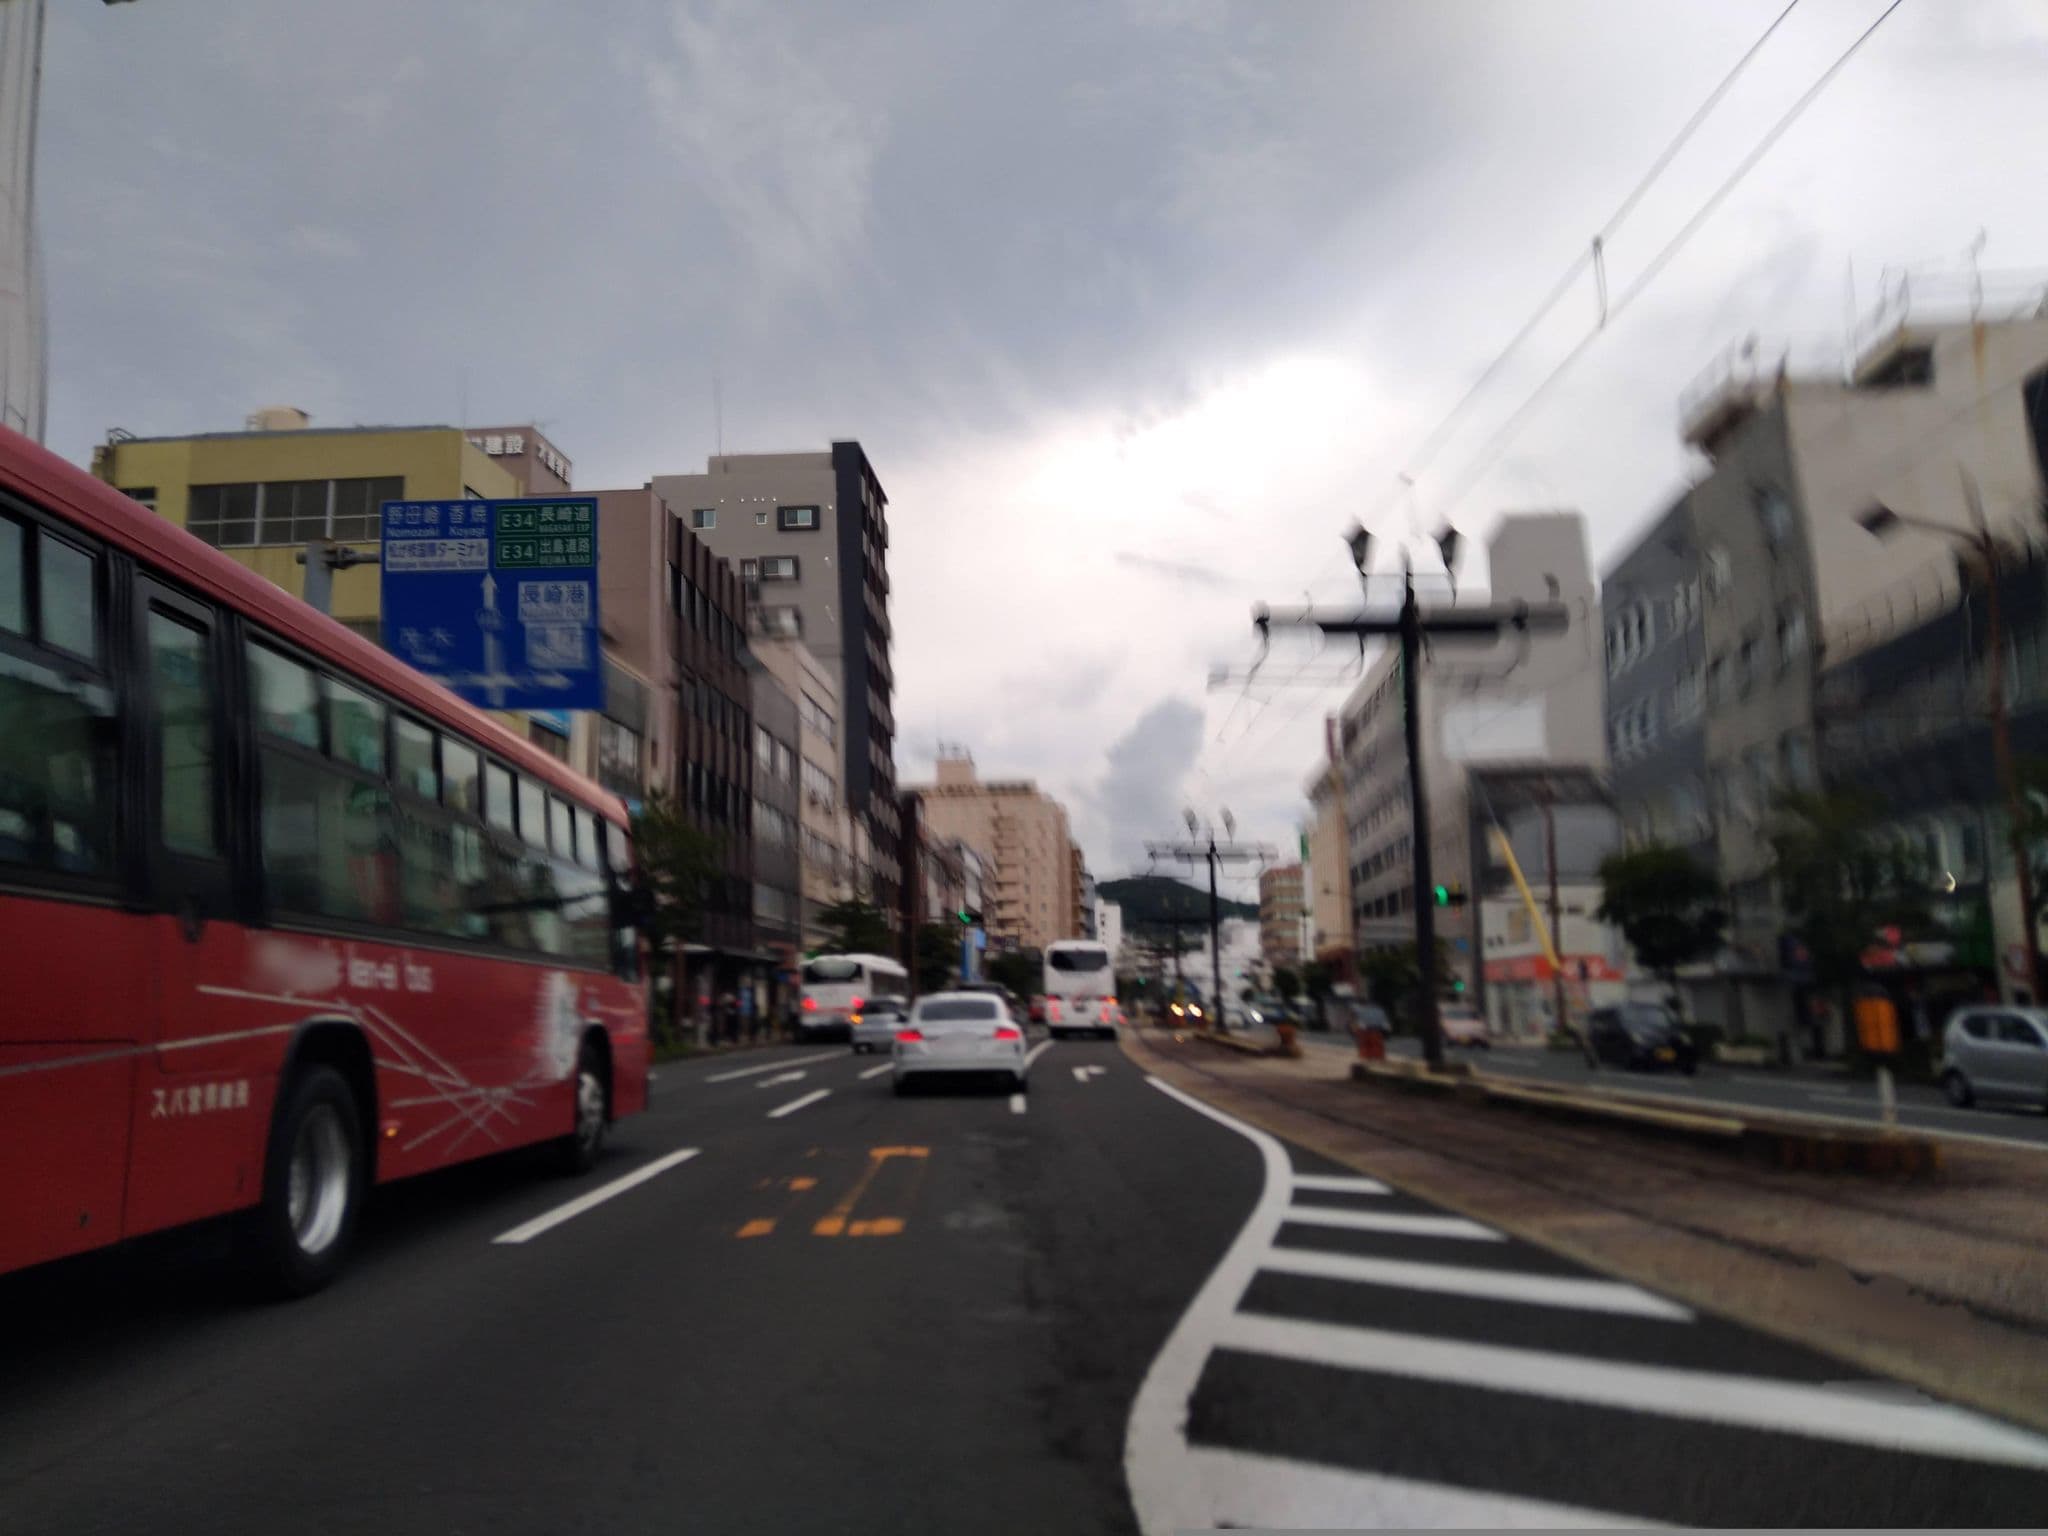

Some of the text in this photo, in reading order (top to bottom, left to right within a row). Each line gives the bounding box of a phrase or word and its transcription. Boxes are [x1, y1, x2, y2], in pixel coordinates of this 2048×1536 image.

[502, 513, 533, 527] E34
[539, 506, 590, 521] 長崎道
[502, 544, 533, 558] E34
[540, 537, 590, 553] 出島道路
[521, 585, 585, 603] 長崎港
